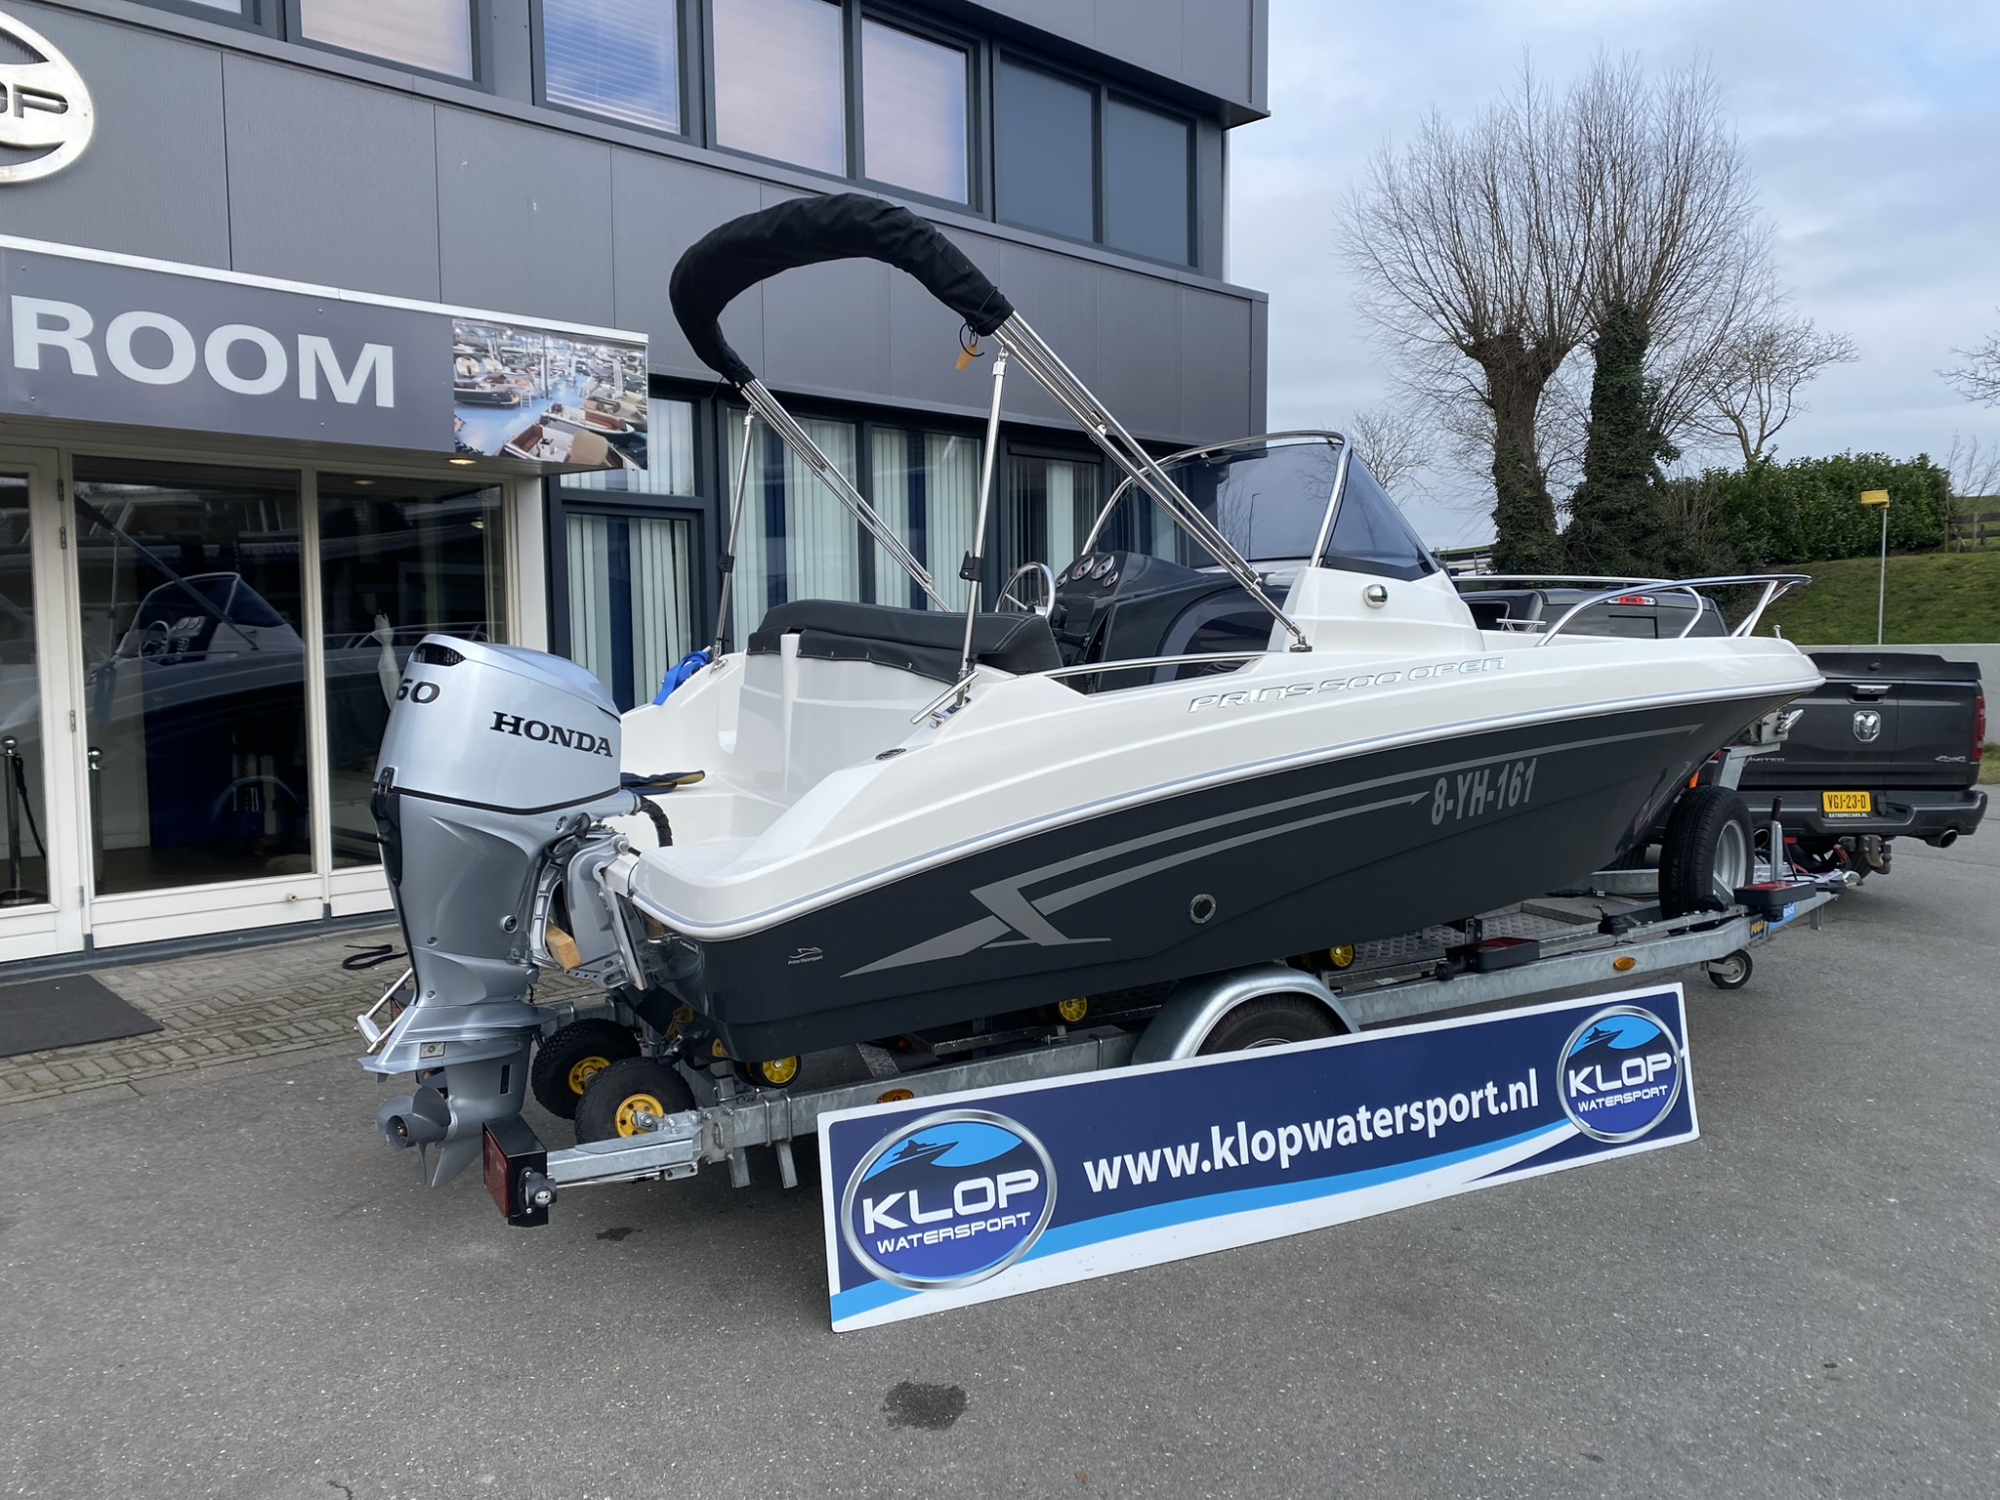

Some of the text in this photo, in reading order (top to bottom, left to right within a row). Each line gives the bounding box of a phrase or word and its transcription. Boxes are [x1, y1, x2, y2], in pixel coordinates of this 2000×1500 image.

[11, 295, 394, 408] ROOM
[1188, 656, 1506, 714] PRINS 500 OPEN
[490, 711, 613, 757] HONDA
[1431, 758, 1537, 825] 8-YH-161
[1568, 1052, 1672, 1098] KLOP
[1578, 1084, 1669, 1113] WATERSPORT
[1083, 1068, 1539, 1193] www.klopwatersport.nl
[862, 1169, 1039, 1235] KLOP
[877, 1211, 1031, 1254] WATERSPORT
